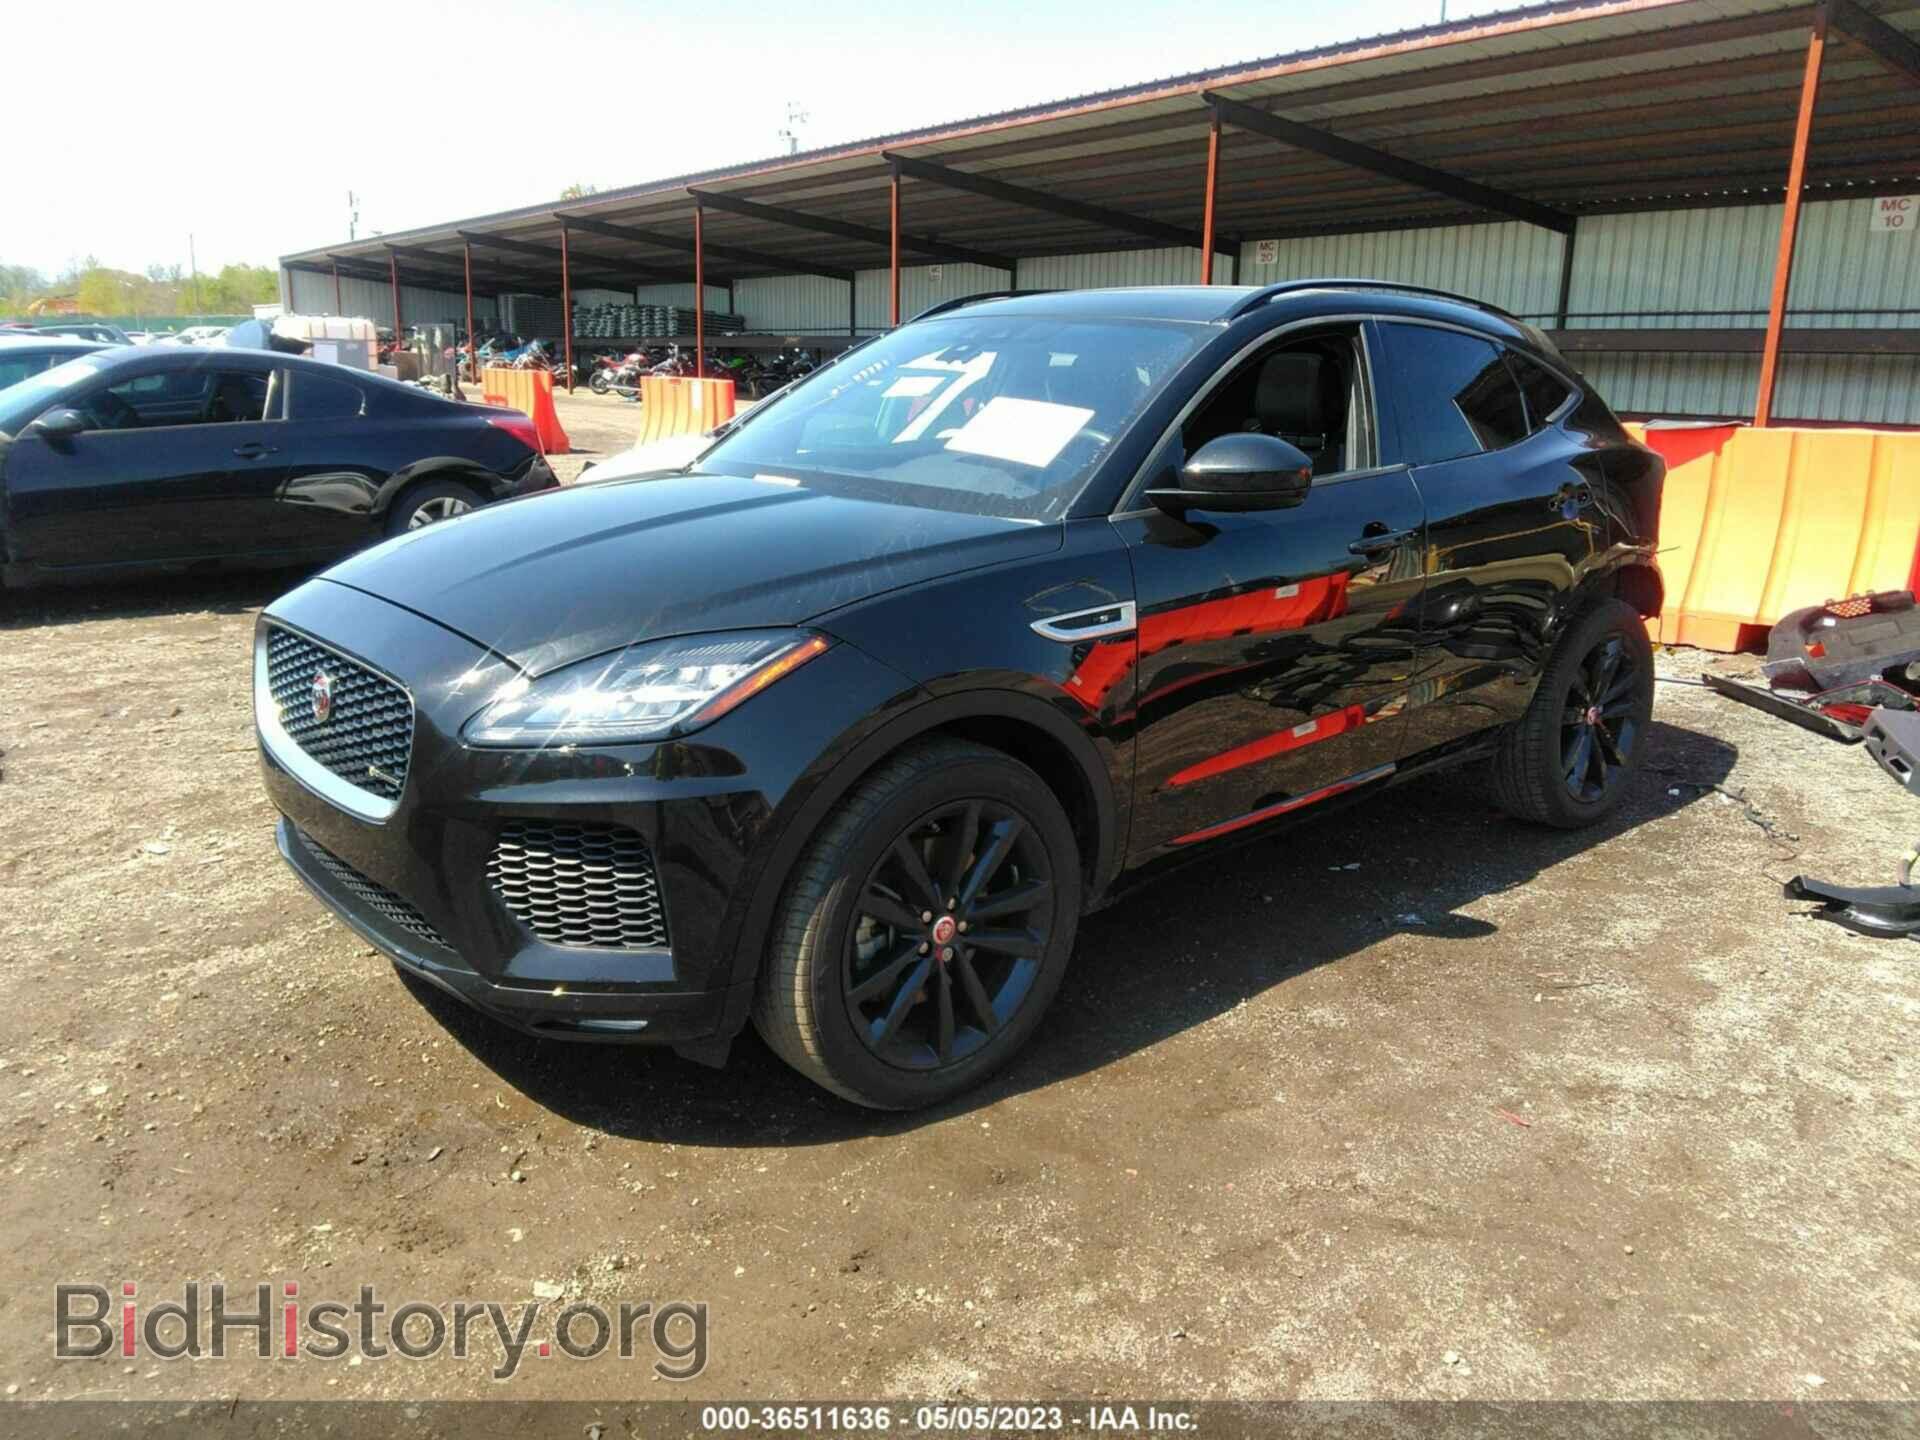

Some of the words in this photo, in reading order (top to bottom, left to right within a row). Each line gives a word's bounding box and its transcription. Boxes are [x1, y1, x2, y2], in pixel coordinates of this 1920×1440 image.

[1881, 199, 1911, 210] MC
[1885, 215, 1905, 228] 10
[1260, 241, 1275, 251] MC
